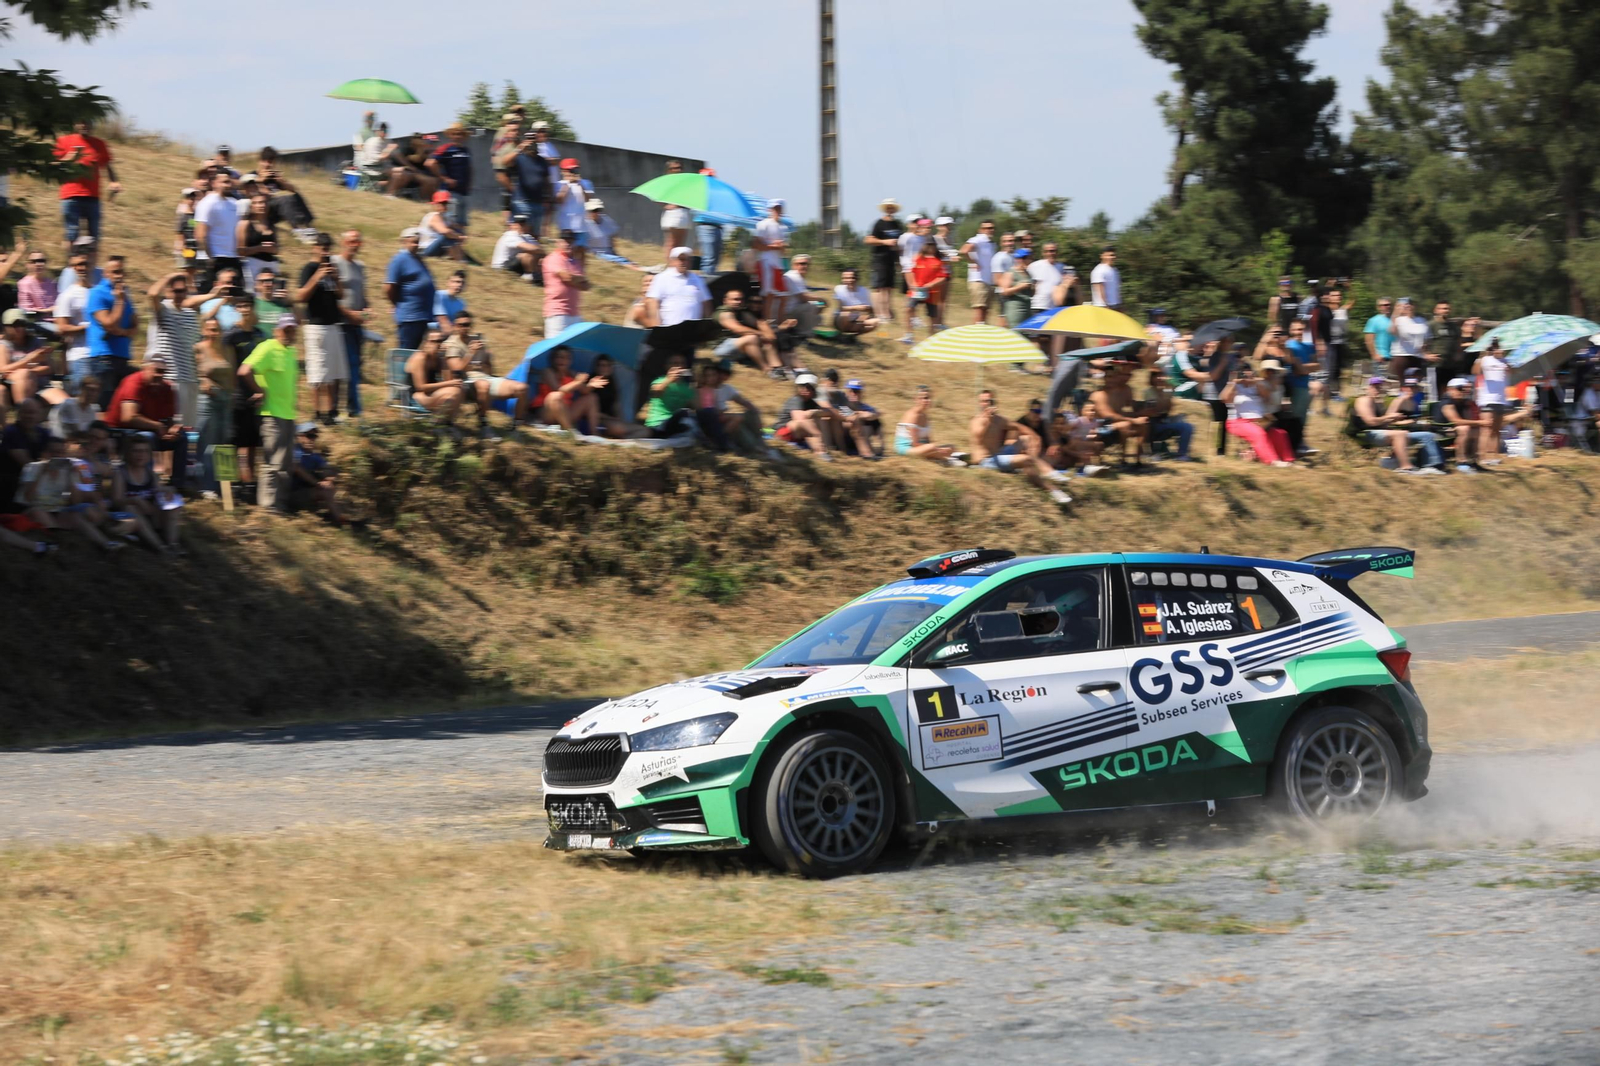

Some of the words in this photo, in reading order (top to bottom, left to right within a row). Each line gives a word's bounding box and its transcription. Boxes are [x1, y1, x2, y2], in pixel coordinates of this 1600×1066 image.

[1161, 602, 1187, 617] J.A.
[1189, 600, 1234, 616] Suárez
[1240, 596, 1262, 630] 1
[1313, 602, 1338, 611] TURINI
[1166, 621, 1181, 635] A.
[1182, 618, 1233, 636] Iglesias
[944, 643, 970, 657] RACC
[1129, 643, 1234, 705] GSS
[807, 688, 868, 701] MICHELIN
[960, 692, 984, 707] La
[928, 691, 944, 718] 1
[1141, 703, 1188, 726] Subsea
[1191, 690, 1244, 712] Services
[943, 724, 977, 738] Recalvi
[947, 746, 980, 757] recoletas
[981, 743, 1000, 752] salud
